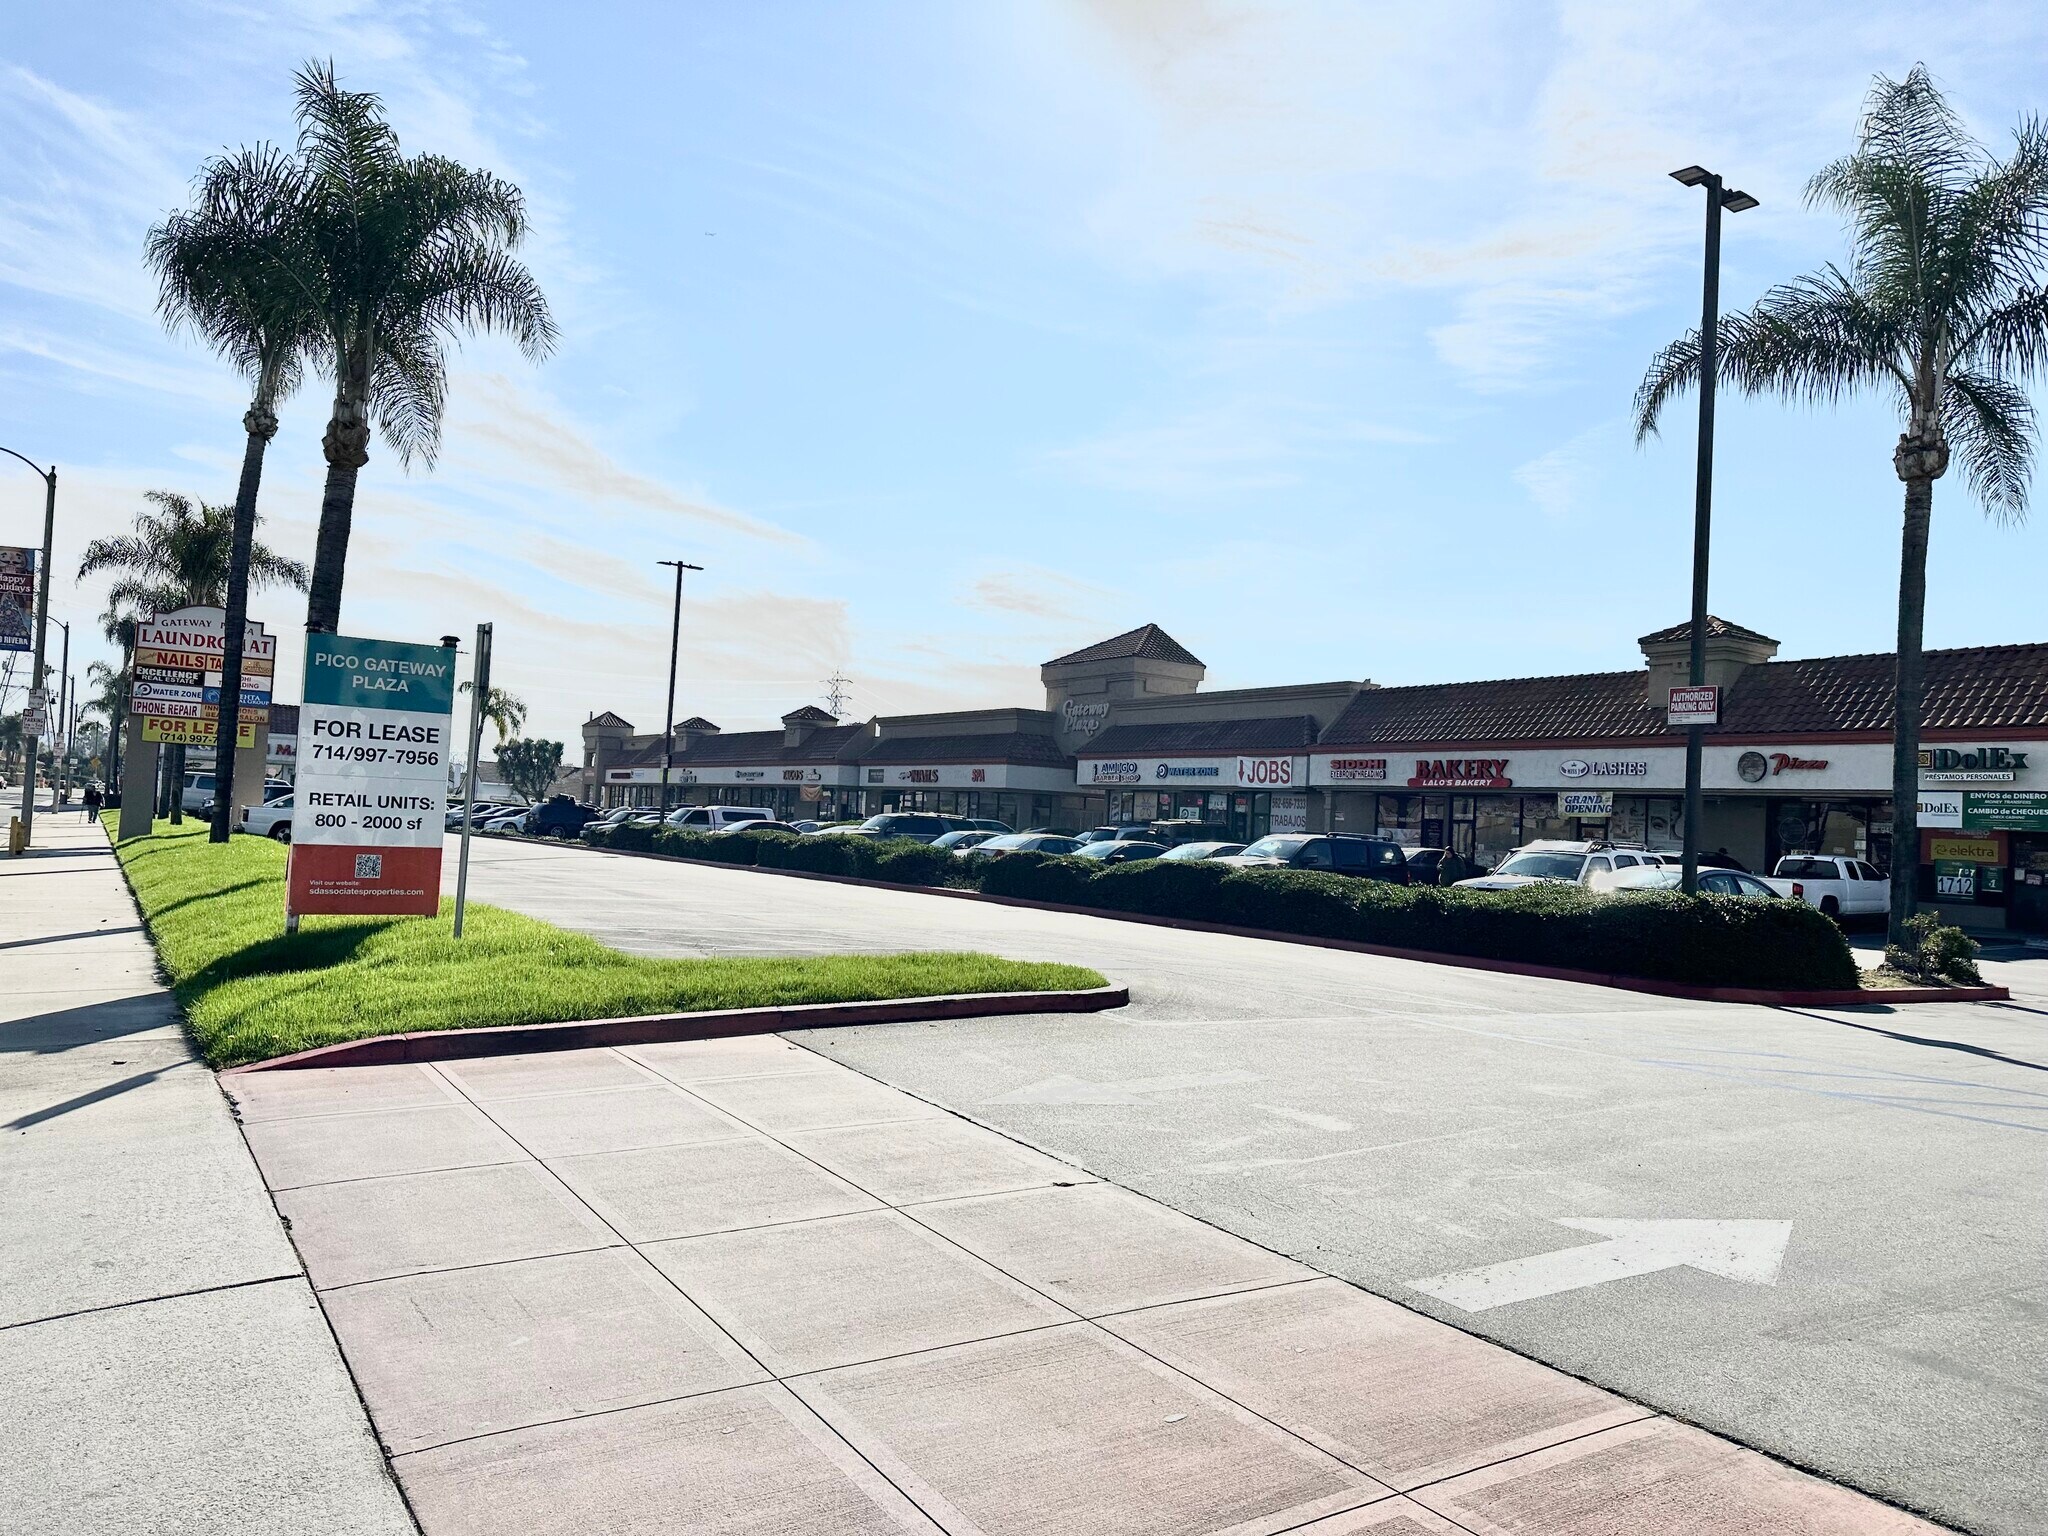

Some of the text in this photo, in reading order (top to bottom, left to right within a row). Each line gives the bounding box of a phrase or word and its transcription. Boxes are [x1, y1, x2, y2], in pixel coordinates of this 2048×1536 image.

[161, 619, 212, 628] GATEWAY
[4, 636, 28, 645] RIVERA
[156, 651, 204, 668] NAILS
[315, 652, 446, 678] PICO GATEWAY
[135, 666, 199, 680] EXCELLENCE
[165, 676, 195, 684] ESTATE
[352, 675, 409, 693] PLAZA
[153, 688, 202, 699] WATER ZONE
[1672, 691, 1714, 702] AUTHORIZED
[133, 701, 198, 716] IPHONE REPAIR
[1062, 699, 1109, 719] Gateway
[1670, 701, 1714, 712] PARKING ONLY
[148, 719, 250, 737] FOR LEE
[313, 719, 440, 744] FOR LEASE
[1063, 716, 1099, 737] Plaza
[160, 733, 187, 743] (714)
[312, 744, 439, 766] 714/997-7956
[1933, 747, 2029, 770] DolEx
[1101, 762, 1138, 773] AMIGO
[1330, 759, 1386, 769] SIDDHI
[1415, 759, 1510, 779] BAKERY
[1591, 761, 1647, 776] LASHES
[1769, 753, 1828, 776] Pizza
[1096, 773, 1140, 782] BARBER SHOP
[1169, 767, 1219, 776] WATER ZONE
[1247, 760, 1291, 785] JOBS
[1354, 769, 1386, 779] THREADING
[1455, 779, 1492, 787] BAKERY
[309, 792, 435, 811] RETAIL UNITS:
[1564, 795, 1603, 804] GRAND
[1564, 804, 1612, 813] OPENING
[1924, 802, 1959, 813] DolEx
[1967, 807, 1999, 815] CAMBIO
[2011, 808, 2048, 816] CHEQUES
[315, 814, 346, 828] 800
[362, 815, 403, 830] 2000
[407, 817, 423, 830] sf
[1270, 814, 1306, 828] TRABAJOS
[1949, 845, 1994, 857] elektra
[309, 887, 424, 897] sdassociatesproperties.com
[1938, 876, 1973, 895] 1712
